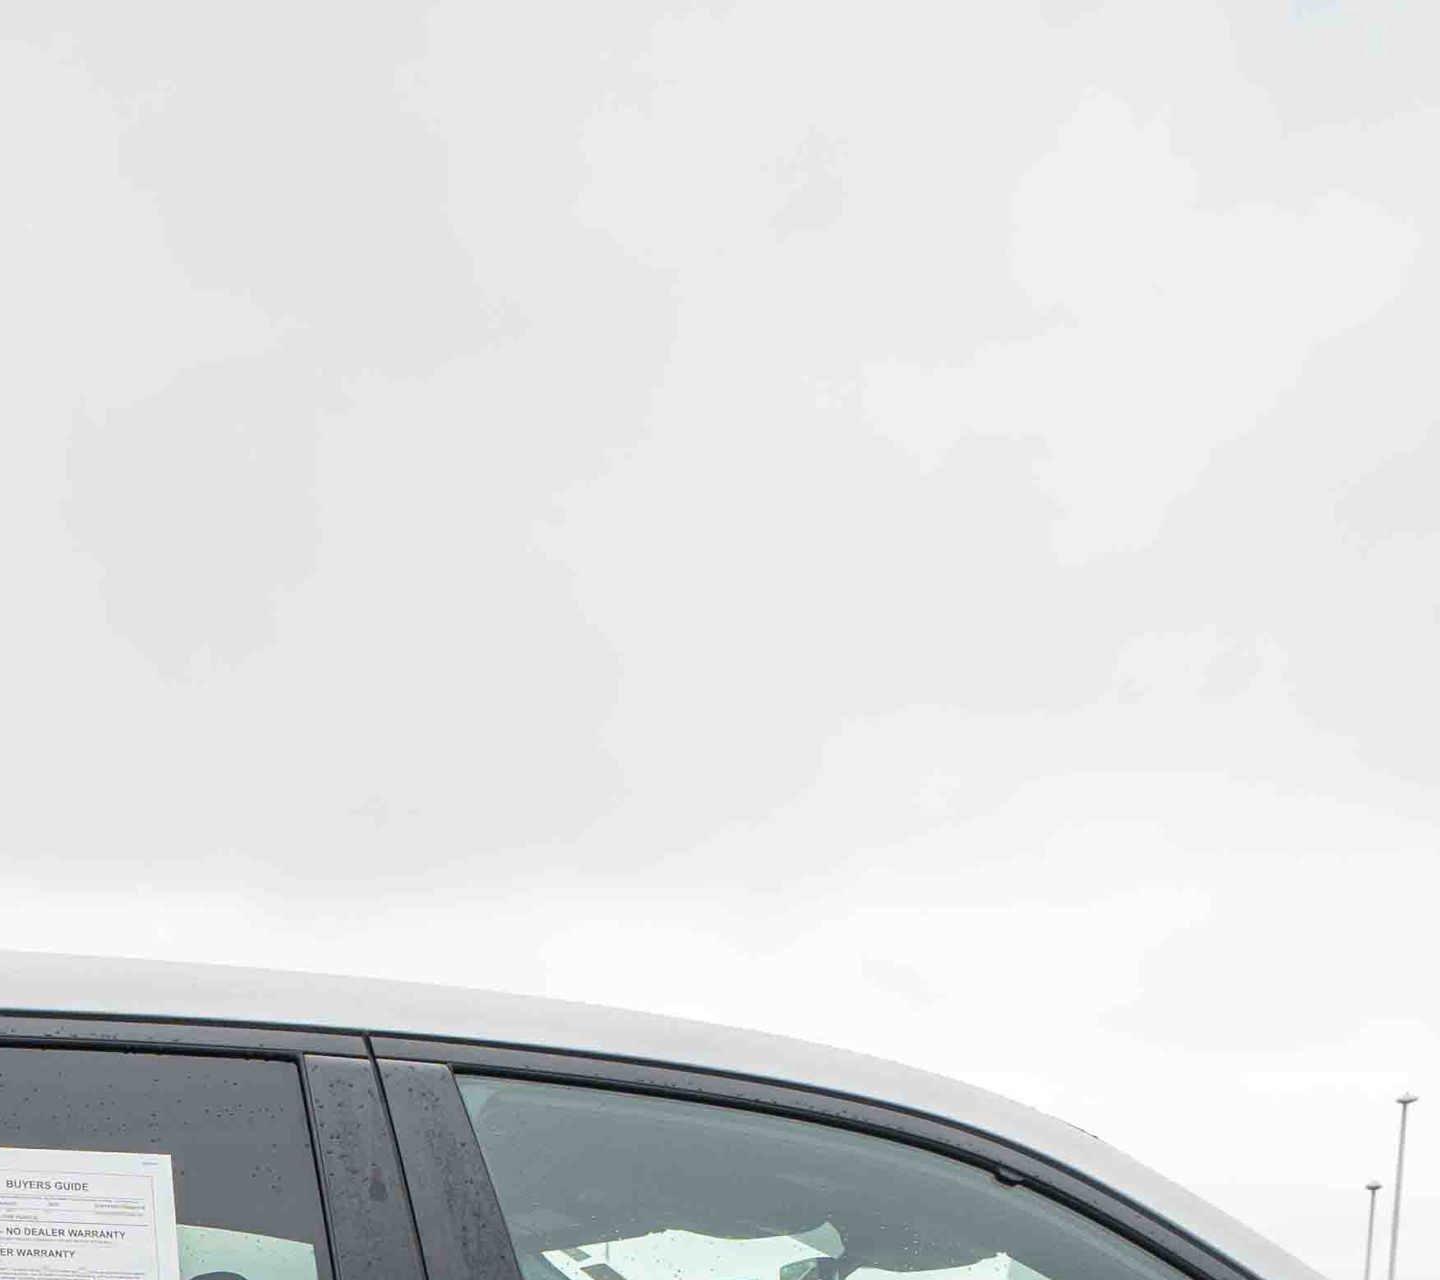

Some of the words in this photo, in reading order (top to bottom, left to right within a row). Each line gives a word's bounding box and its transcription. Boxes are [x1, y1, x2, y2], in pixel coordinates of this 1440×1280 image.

[6, 1179, 51, 1190] BUYERS
[54, 1181, 89, 1192] GUIDE
[6, 1226, 21, 1235] NO
[24, 1227, 65, 1237] DEALER
[67, 1229, 126, 1239] WARRANTY
[16, 1248, 76, 1259] WARRANTY
